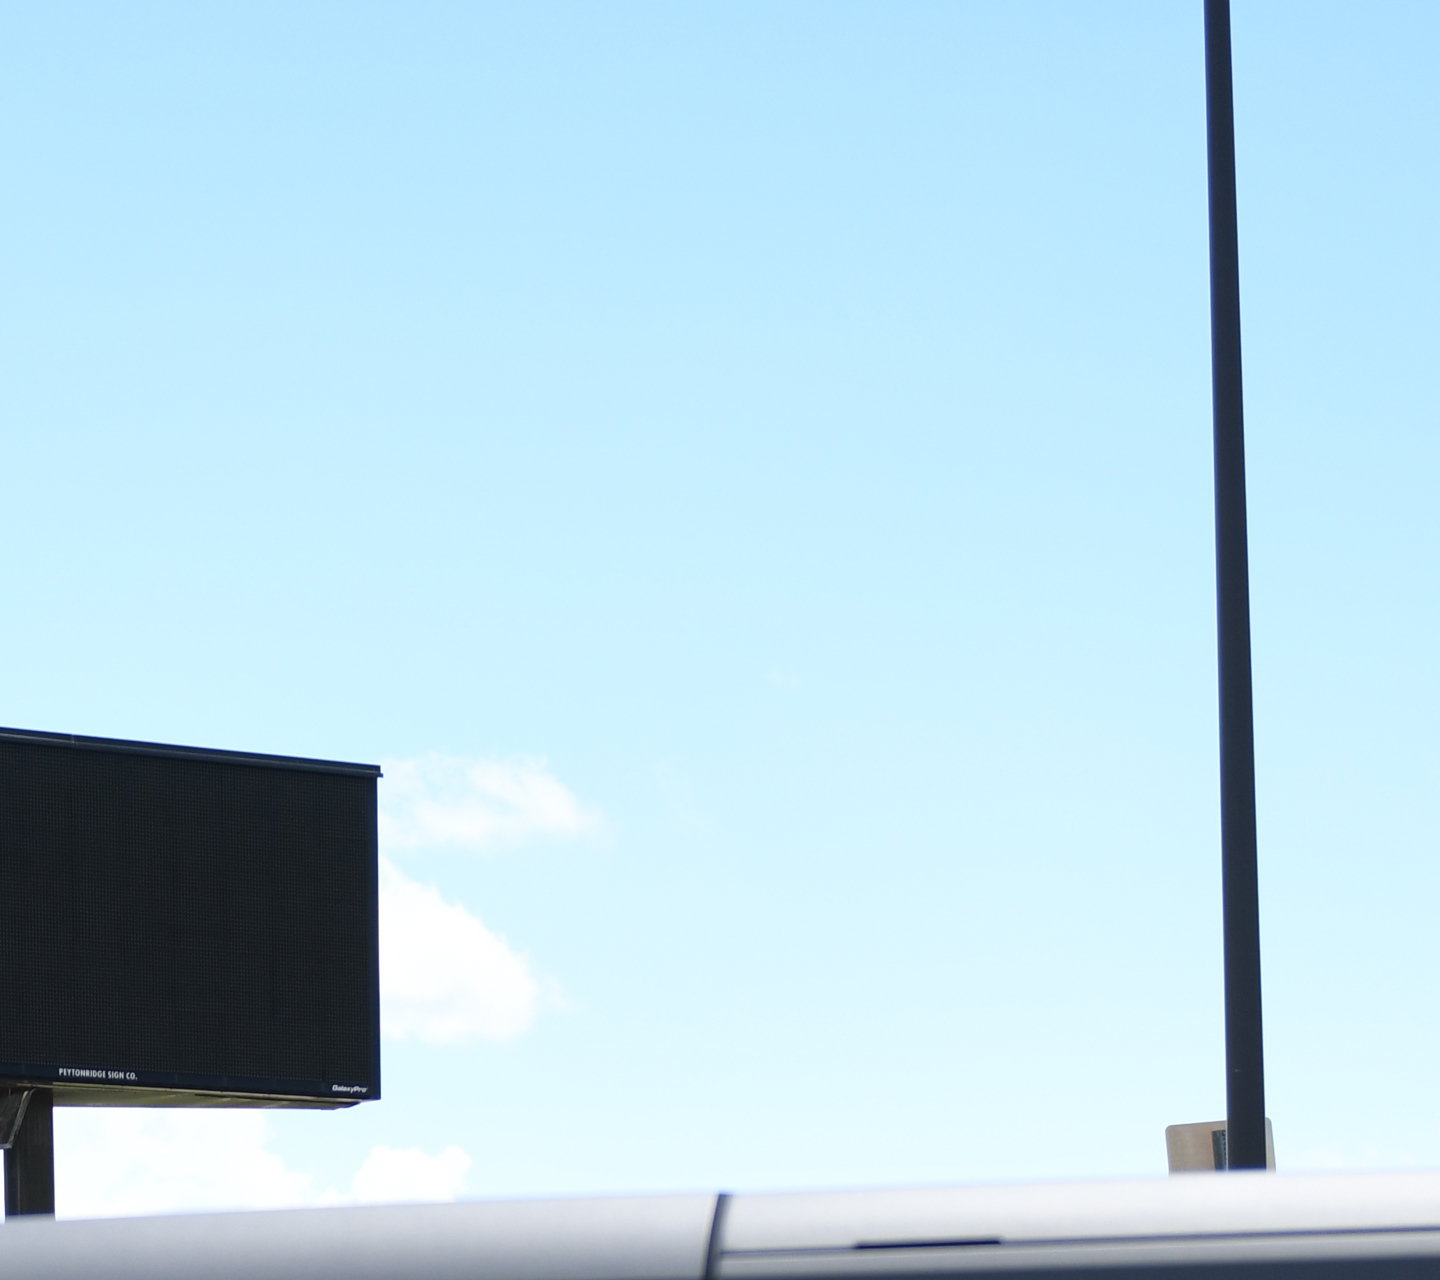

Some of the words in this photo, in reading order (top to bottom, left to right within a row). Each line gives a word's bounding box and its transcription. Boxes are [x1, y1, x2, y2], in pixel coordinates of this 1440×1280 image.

[58, 1067, 106, 1078] PEYTONRIDGE
[107, 1070, 124, 1079] SIGN
[125, 1071, 138, 1081] CO.
